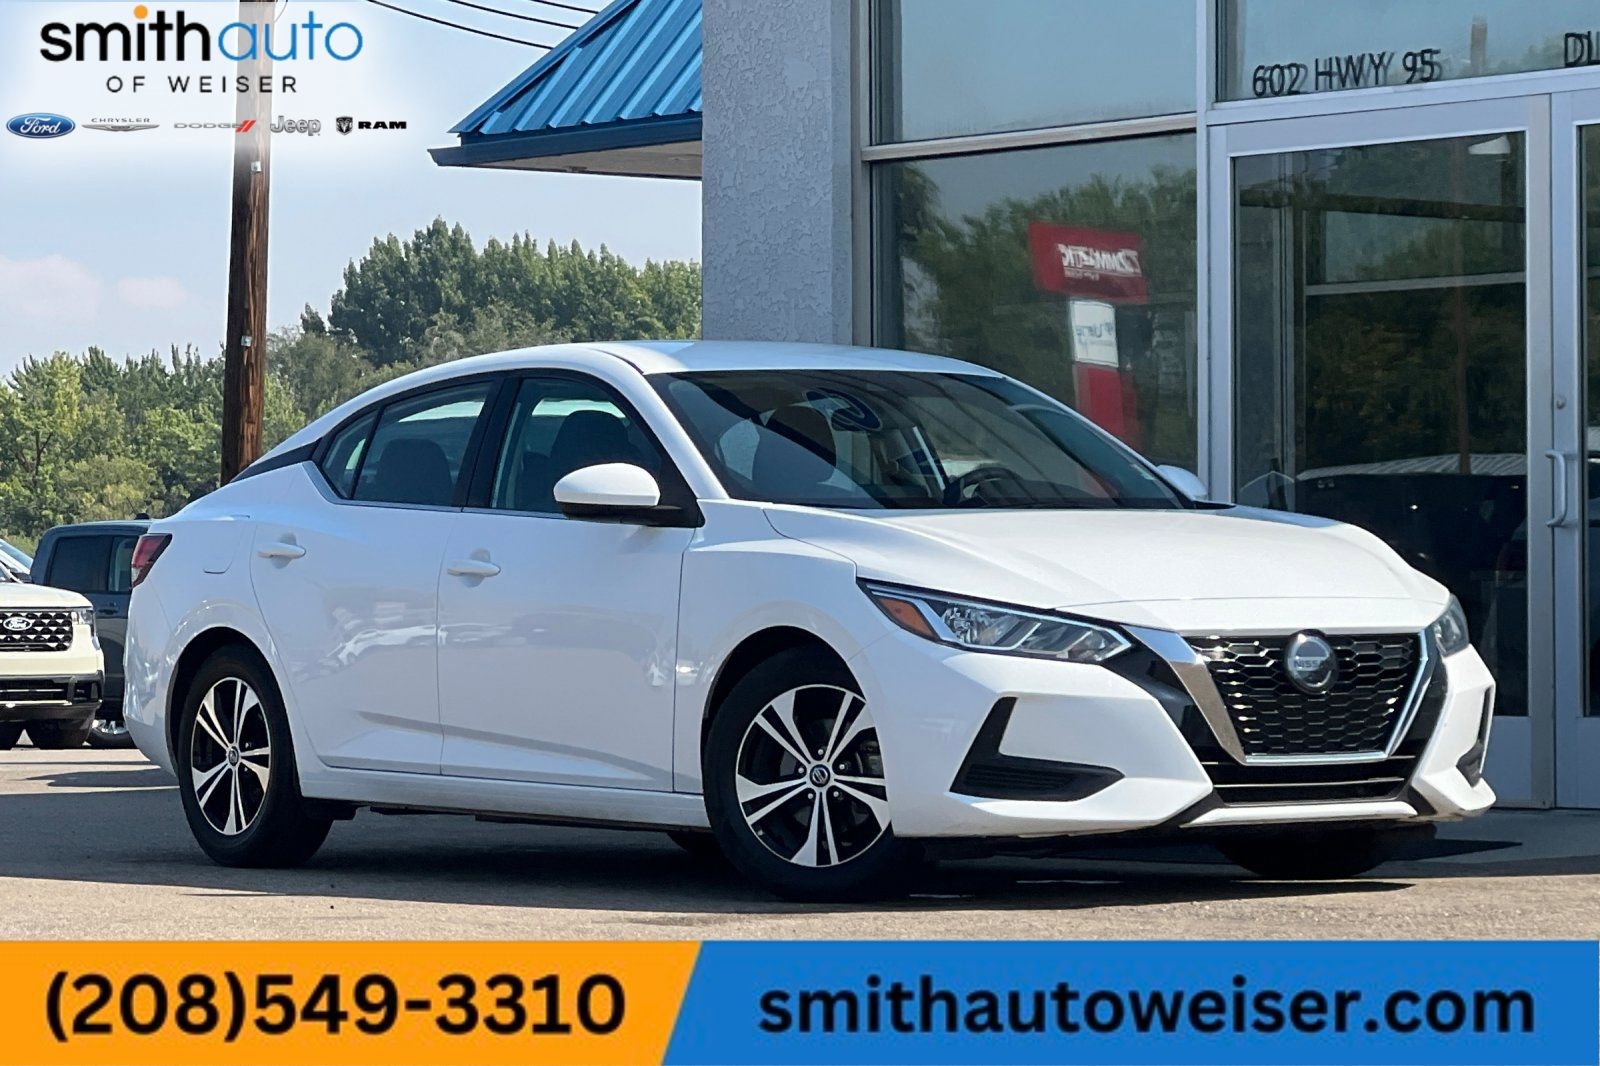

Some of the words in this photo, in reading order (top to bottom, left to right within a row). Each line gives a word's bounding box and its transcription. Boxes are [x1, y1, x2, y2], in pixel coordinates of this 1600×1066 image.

[1253, 62, 1306, 97] 602
[1315, 52, 1391, 91] HWY
[1402, 49, 1439, 84] 95
